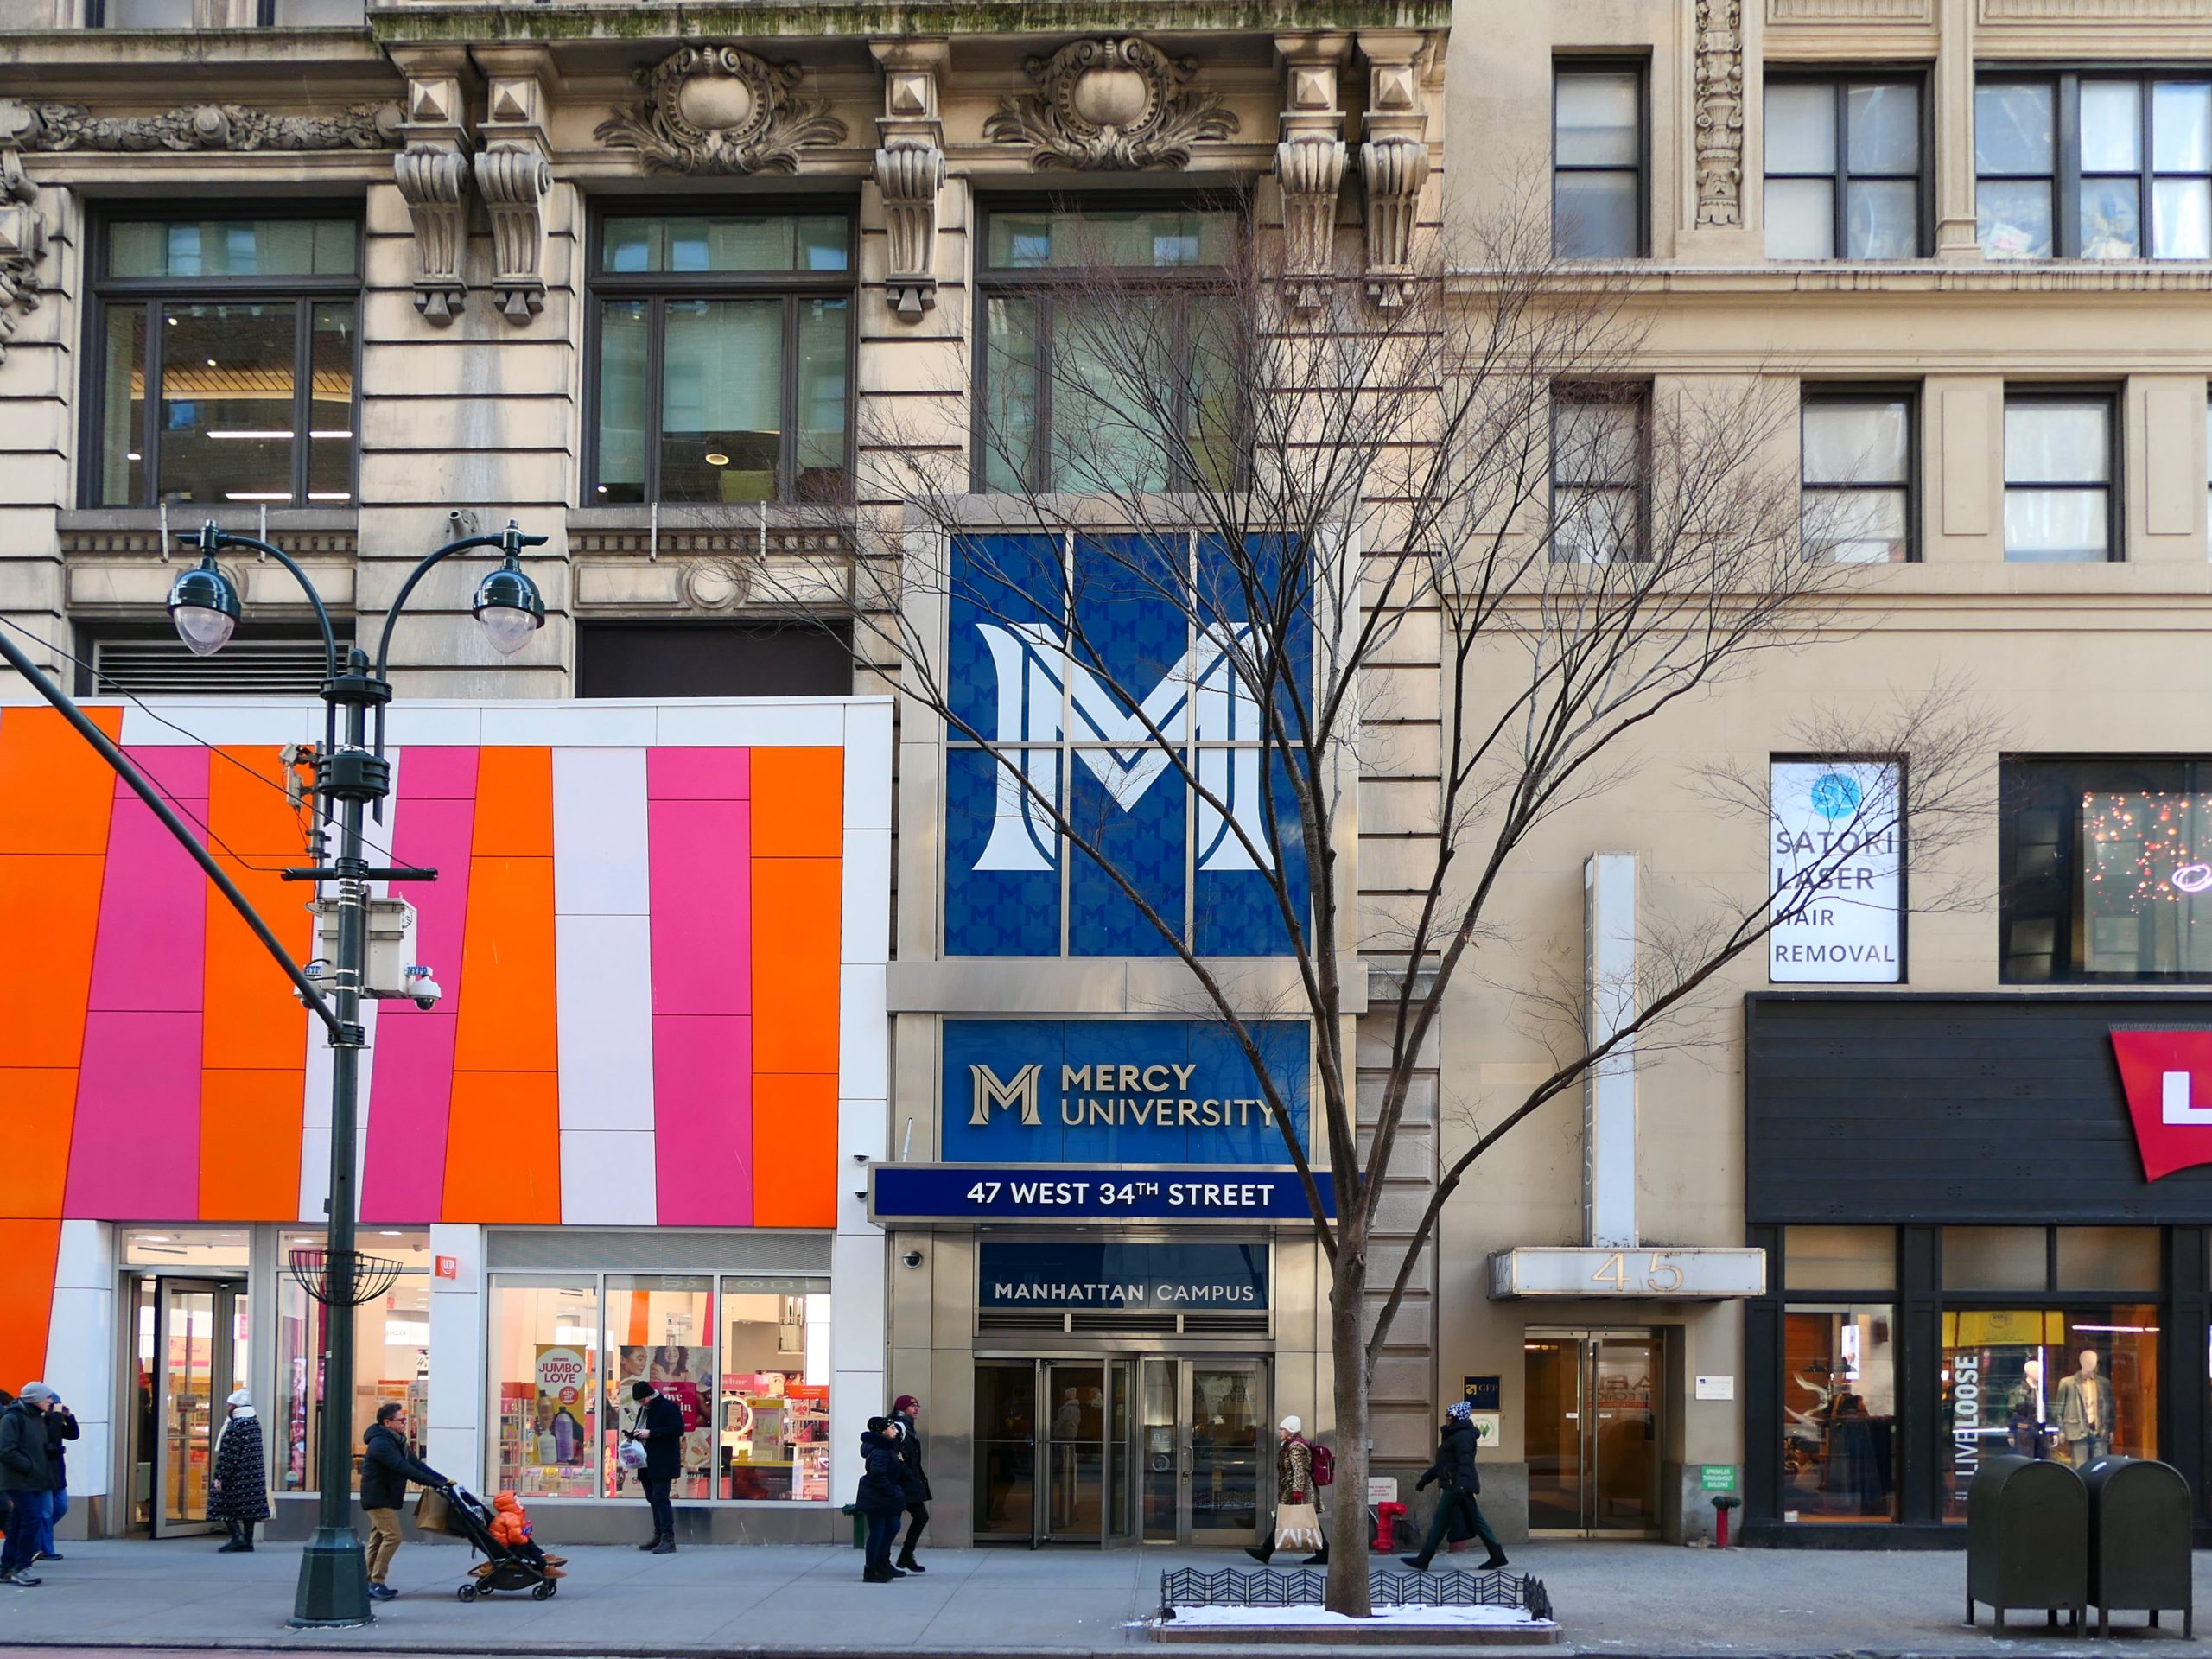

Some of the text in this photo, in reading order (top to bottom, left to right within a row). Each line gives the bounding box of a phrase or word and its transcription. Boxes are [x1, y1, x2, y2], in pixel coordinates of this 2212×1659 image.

[1776, 831, 1892, 855] SATORI
[1777, 868, 1874, 890] LASER
[1775, 945, 1895, 963] REMOVAL
[407, 966, 428, 976] NYPD
[1062, 1064, 1197, 1092] MERCY
[969, 1064, 1044, 1126] M
[1061, 1098, 1274, 1127] UNIVERSITY
[966, 1182, 1001, 1204] 47
[1010, 1182, 1090, 1205] WEST
[1168, 1183, 1274, 1206] STREET
[995, 1283, 1255, 1302] MANHATTAN CAMPUS
[538, 1363, 582, 1374] JUMBO
[544, 1373, 576, 1383] LOVE
